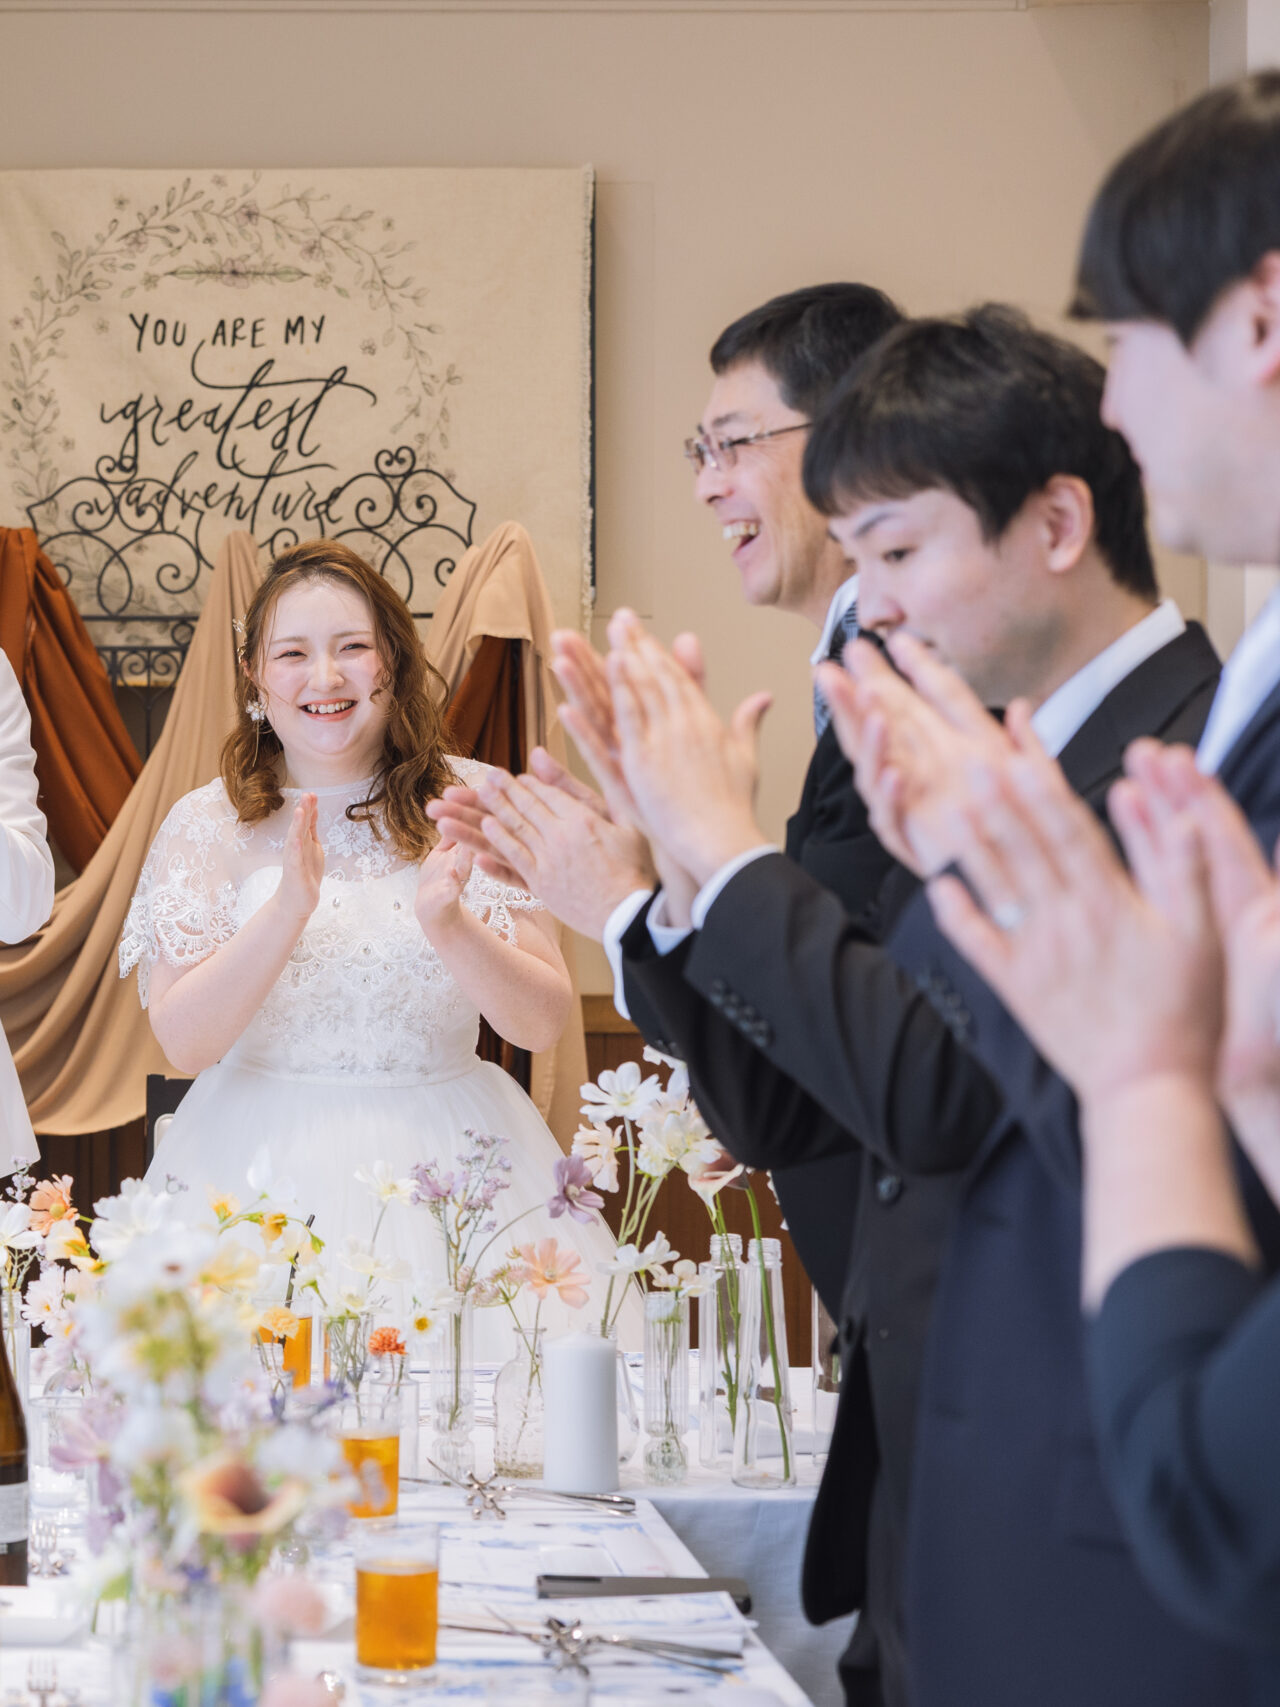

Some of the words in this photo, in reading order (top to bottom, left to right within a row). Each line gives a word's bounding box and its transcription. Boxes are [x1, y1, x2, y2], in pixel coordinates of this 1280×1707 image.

[129, 312, 187, 352] YOU
[211, 317, 266, 348] ARE
[284, 314, 325, 345] MY
[100, 339, 377, 473] greatest
[93, 444, 343, 536] adventure
